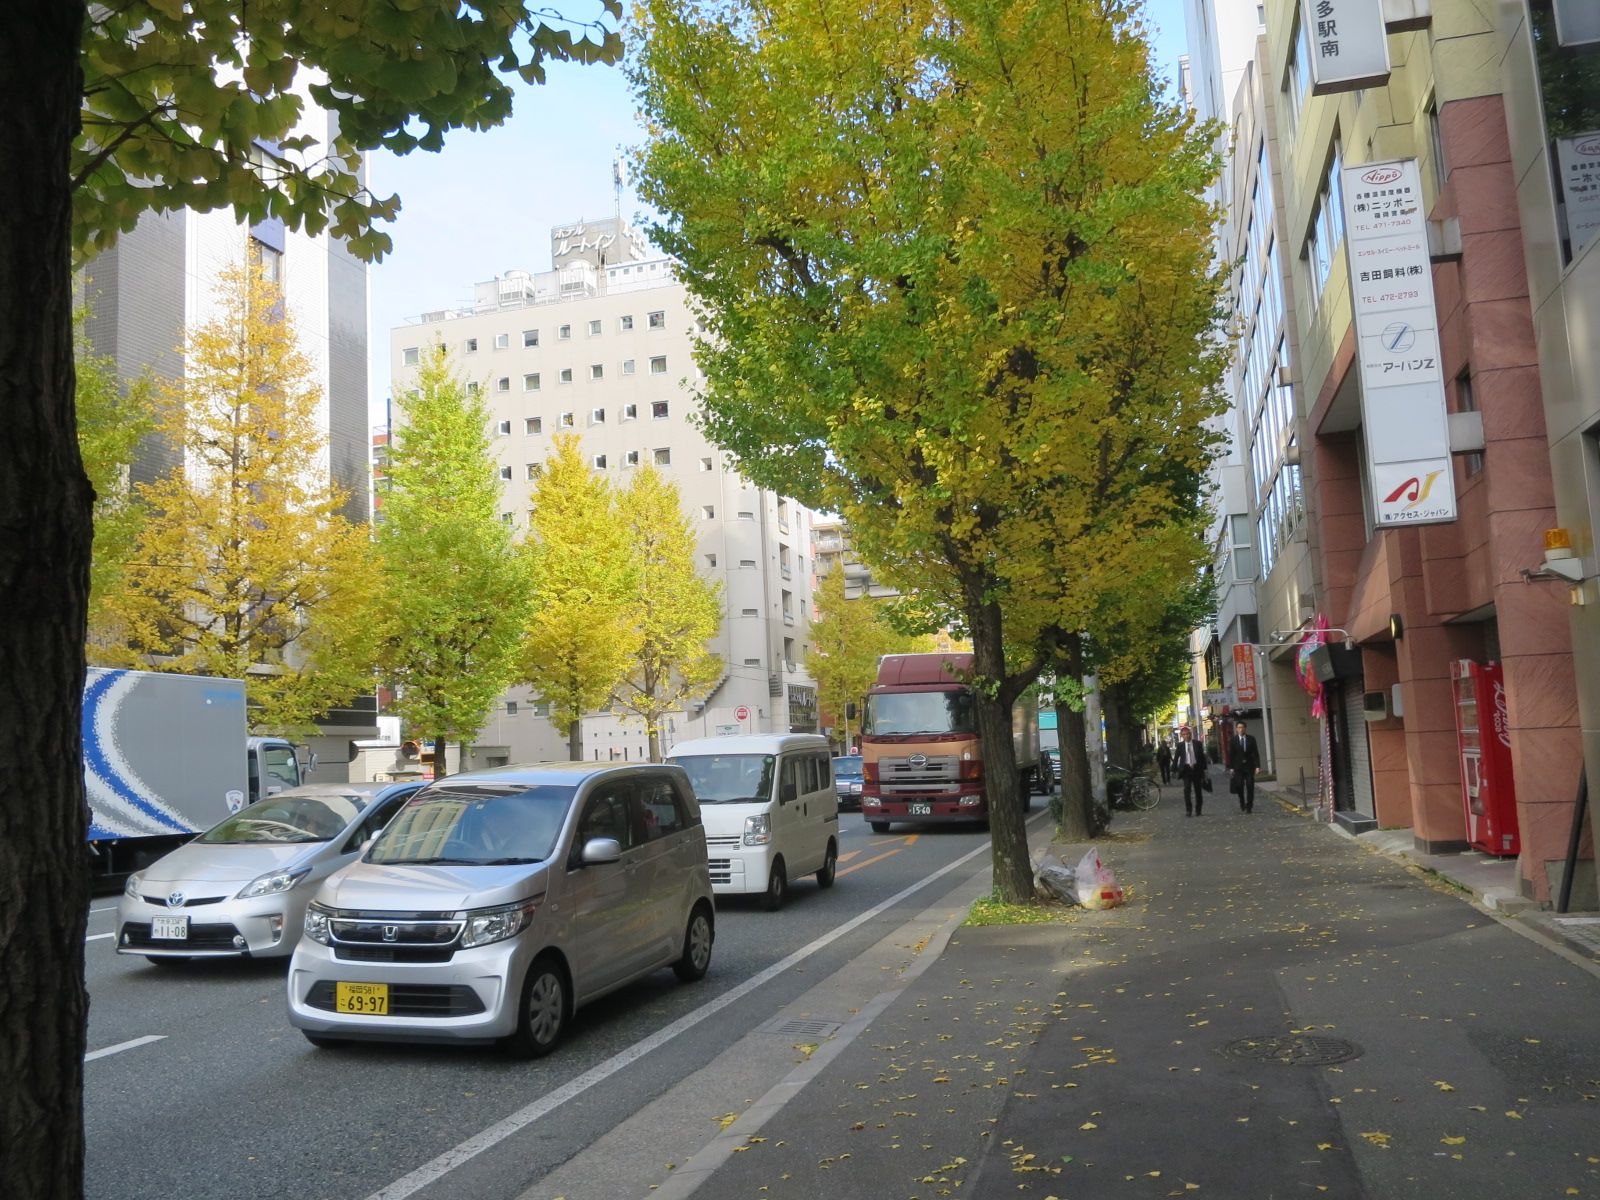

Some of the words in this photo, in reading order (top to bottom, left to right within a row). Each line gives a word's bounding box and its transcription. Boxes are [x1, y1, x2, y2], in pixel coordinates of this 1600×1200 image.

[1316, 0, 1340, 58] 多駅南
[1356, 223, 1371, 231] TEL
[1373, 219, 1412, 230] 471-7340
[554, 234, 617, 257] ルートイン
[1359, 264, 1423, 282] 吉田飼料(株)
[1362, 296, 1377, 304] TEL
[1380, 290, 1419, 301] 472-2793
[347, 995, 385, 1013] 69-97
